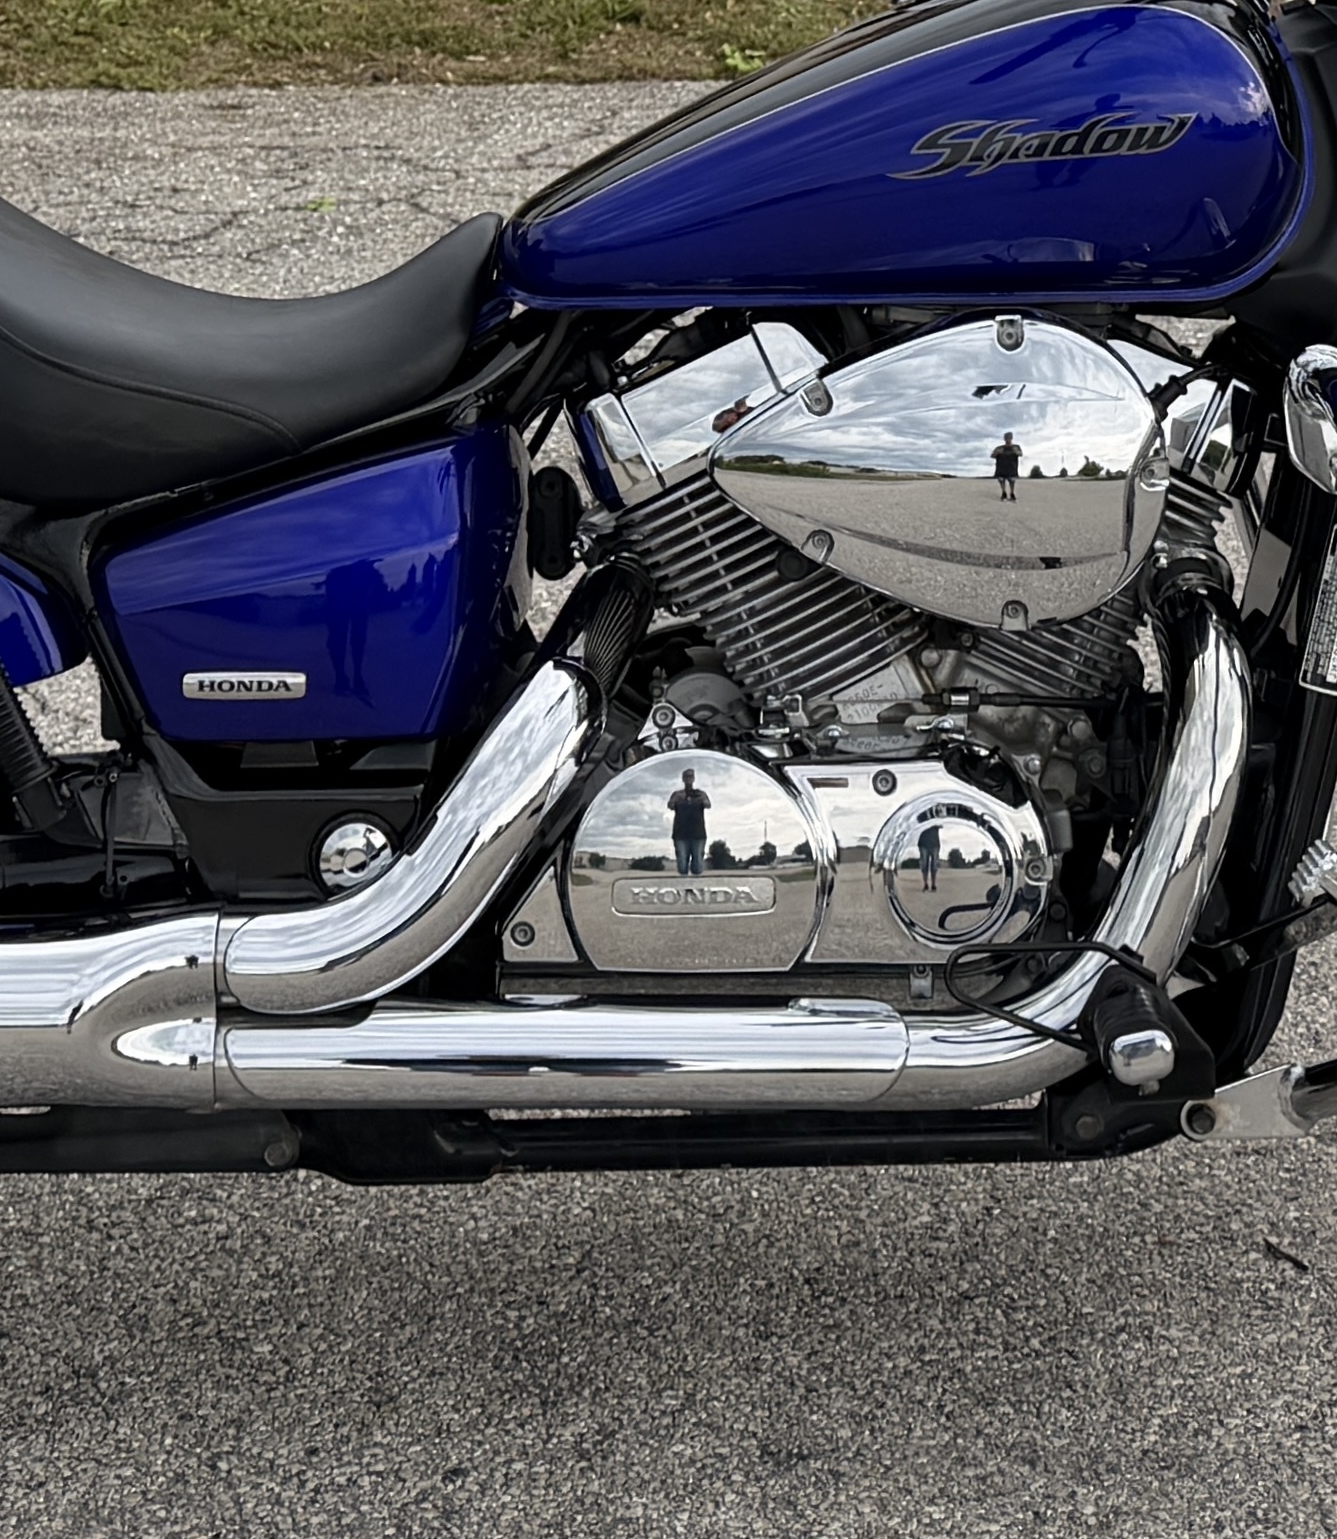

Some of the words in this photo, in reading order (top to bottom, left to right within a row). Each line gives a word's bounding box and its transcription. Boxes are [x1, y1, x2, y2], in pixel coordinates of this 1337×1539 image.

[885, 111, 1200, 180] Shadow
[197, 679, 293, 693] HONDA
[630, 886, 759, 906] HONDA
